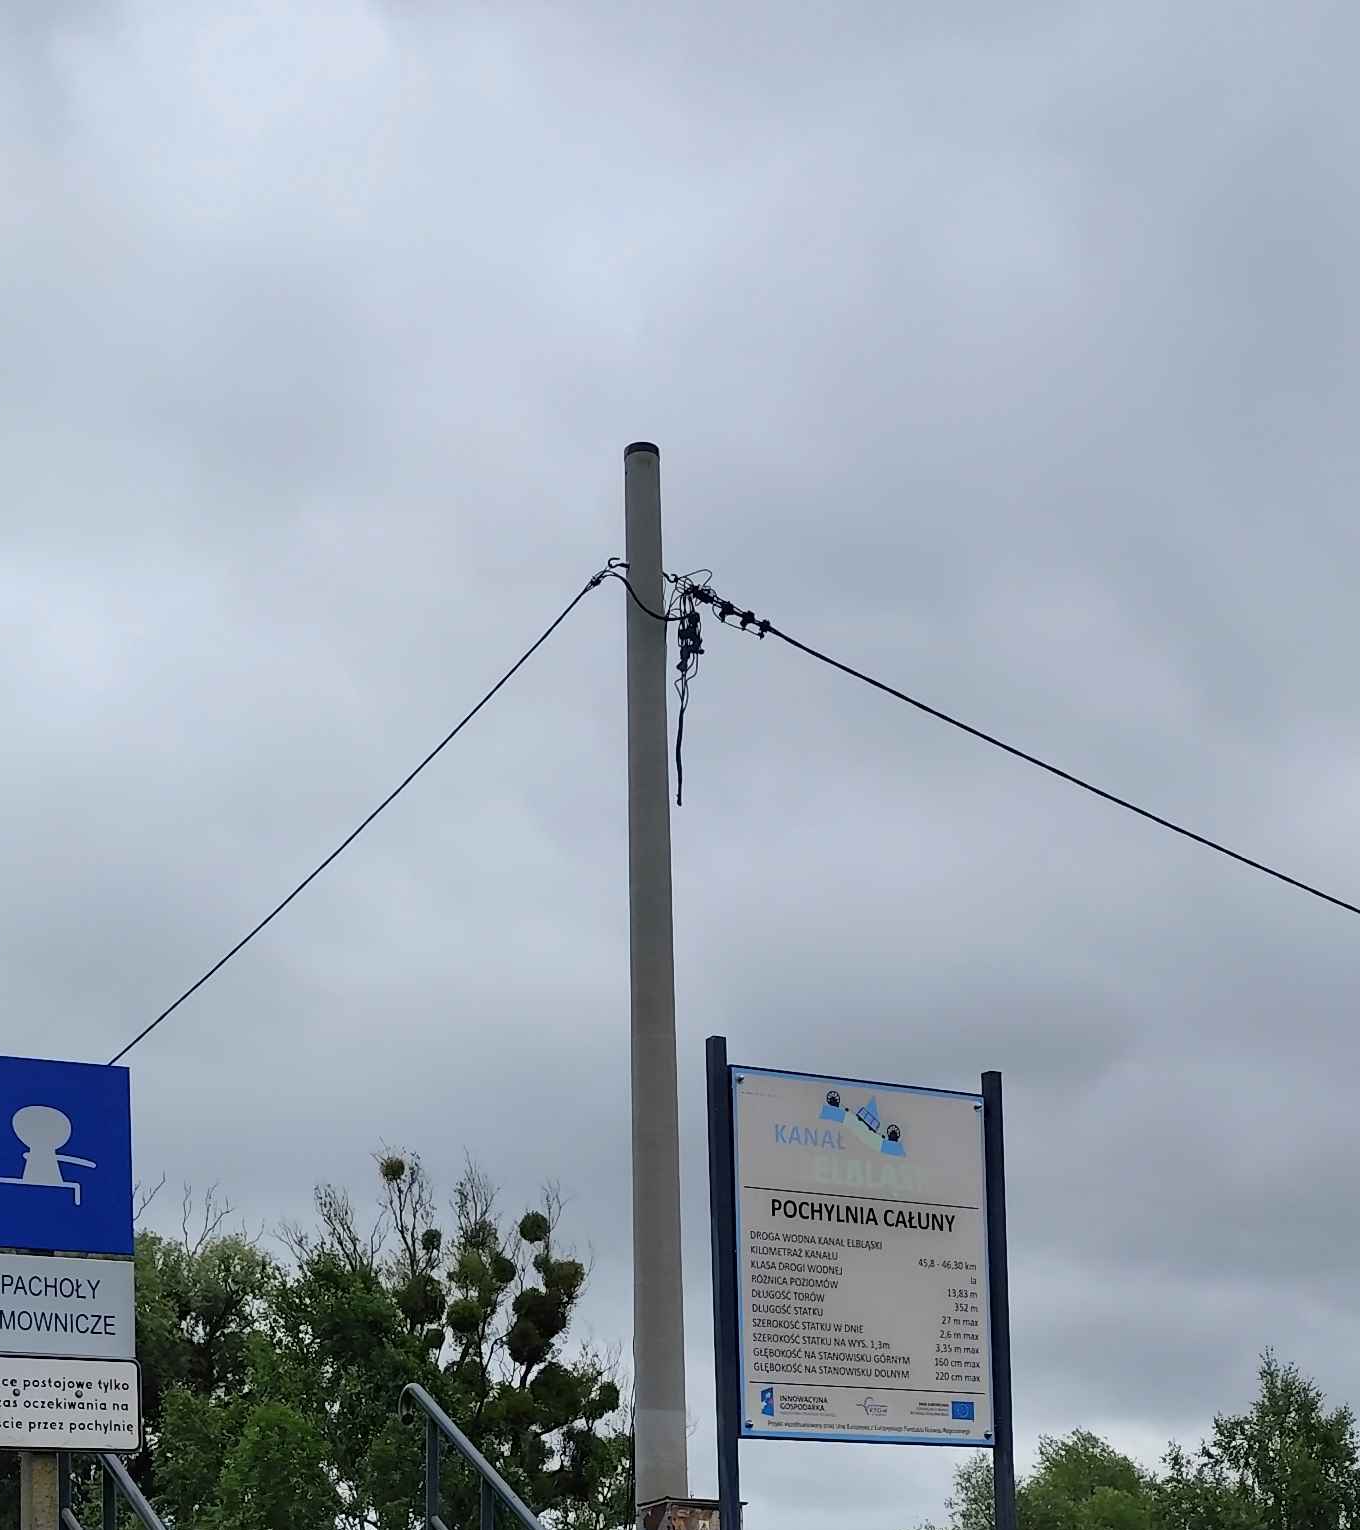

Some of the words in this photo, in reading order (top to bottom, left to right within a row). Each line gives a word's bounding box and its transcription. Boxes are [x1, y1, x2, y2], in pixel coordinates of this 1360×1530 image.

[771, 1199, 878, 1226] POCHYLNIA
[883, 1209, 956, 1233] CAŁUNY
[750, 1230, 780, 1241] DROGA
[782, 1233, 816, 1245] WODNA
[750, 1260, 777, 1271] KLASA
[778, 1262, 806, 1273] DROGI
[807, 1264, 843, 1276] WODNEJ
[1, 1274, 101, 1299] PACHOŁY
[790, 1277, 839, 1289] POZIOMÓW
[970, 1291, 978, 1299] m
[794, 1306, 824, 1317] STATKU
[954, 1302, 969, 1313] 352
[802, 1321, 832, 1332] STATKU
[833, 1323, 842, 1333] W
[844, 1324, 865, 1334] DNIE
[941, 1316, 951, 1325] 27
[953, 1318, 961, 1326] m
[962, 1319, 979, 1327] max
[802, 1335, 832, 1347] STATKU
[834, 1337, 847, 1348] NA
[963, 1332, 979, 1340] max
[954, 1345, 962, 1353] m
[964, 1346, 980, 1354] max
[804, 1350, 817, 1360] NA
[818, 1351, 872, 1363] STANOWISKU
[950, 1359, 962, 1368] cm
[964, 1360, 980, 1369] max
[804, 1364, 818, 1375] NA
[818, 1366, 872, 1377] STANOWISKU
[874, 1368, 910, 1380] DOLNYM
[935, 1371, 950, 1381] 220
[951, 1373, 963, 1382] cm
[964, 1374, 981, 1383] max
[23, 1376, 93, 1391] postojowe
[97, 1379, 130, 1394] tylko
[23, 1397, 107, 1411] oczekiwania
[112, 1401, 129, 1412] na
[28, 1420, 64, 1432] przez
[69, 1420, 135, 1436] pochylnię
